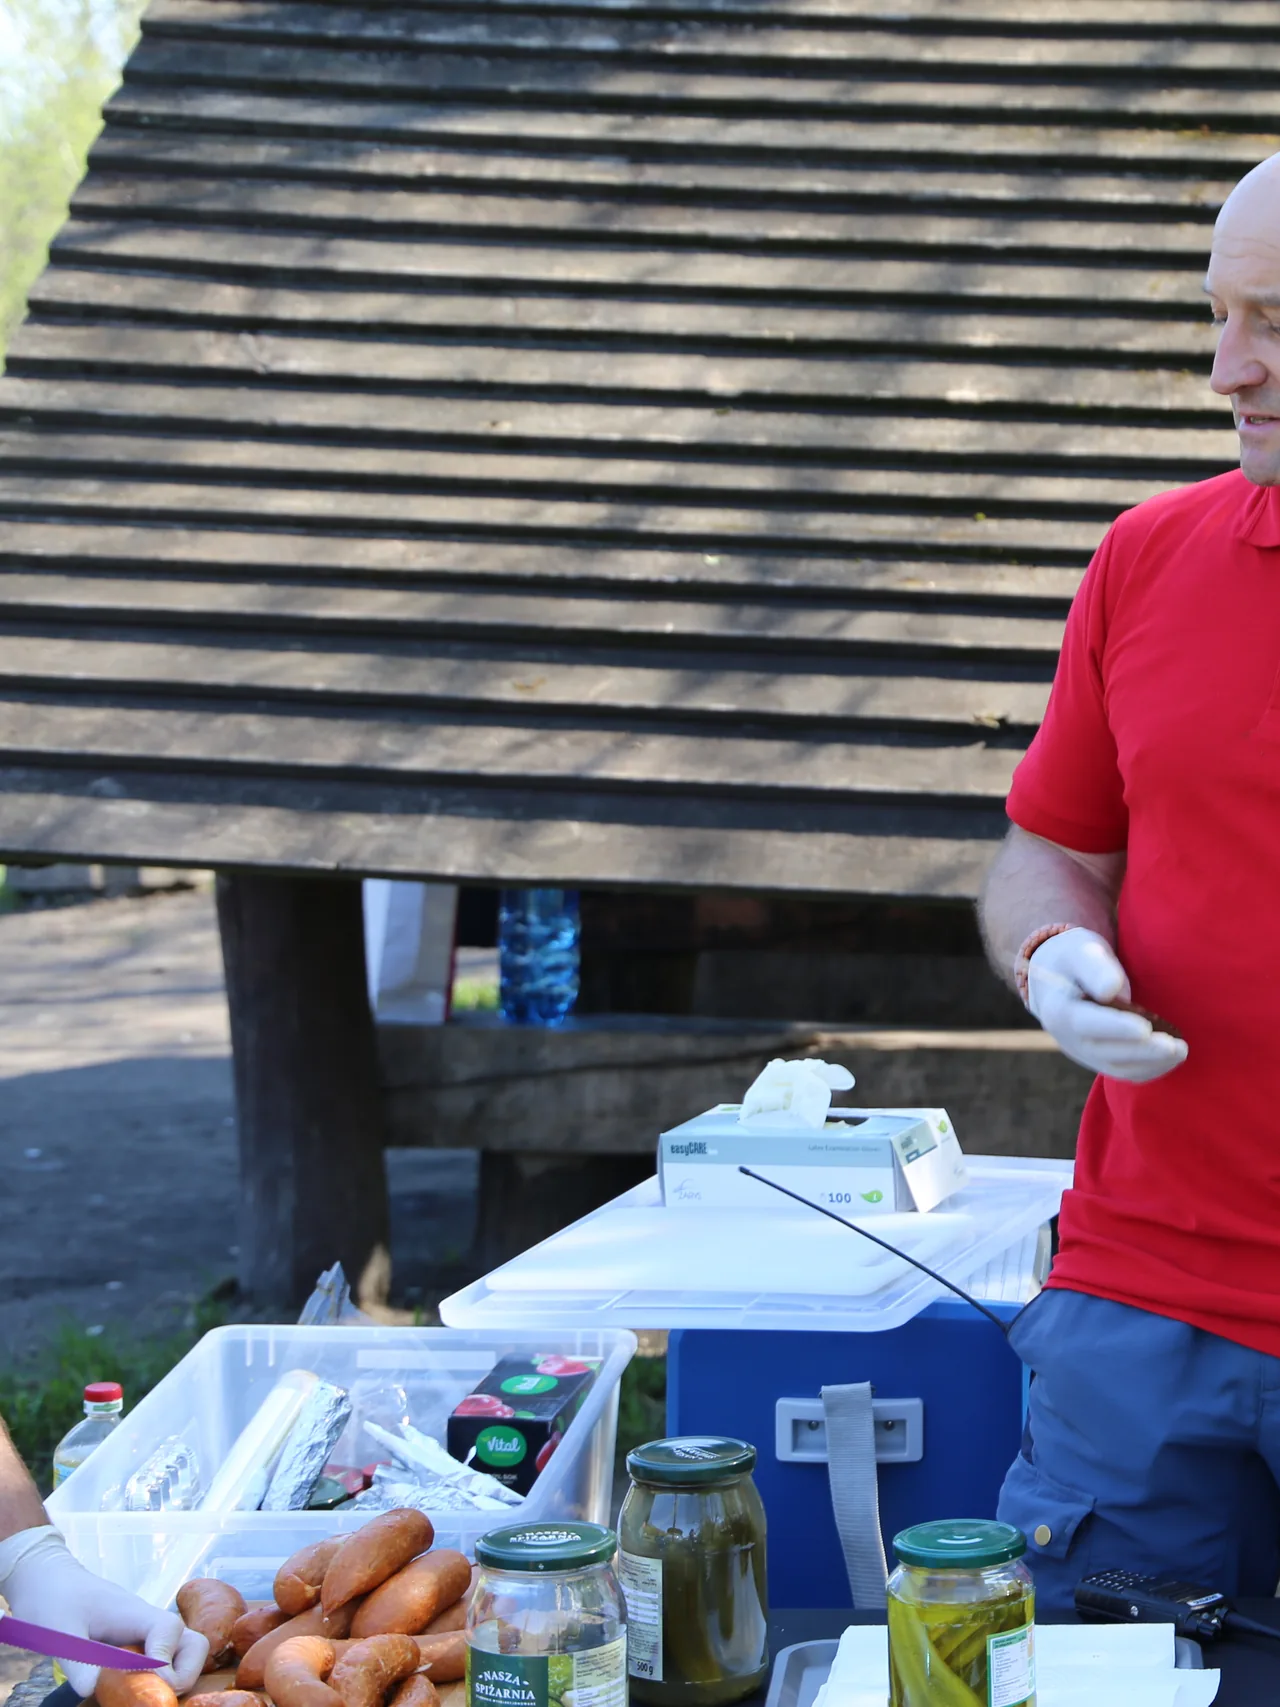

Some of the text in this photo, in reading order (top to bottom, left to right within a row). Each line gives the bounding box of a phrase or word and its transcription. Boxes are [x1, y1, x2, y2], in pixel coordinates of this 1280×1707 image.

[670, 1141, 707, 1156] easyCARE
[828, 1192, 852, 1203] 100
[487, 1436, 521, 1452] Vital
[636, 1661, 654, 1676] 500 g
[484, 1670, 520, 1686] NASZA
[475, 1682, 536, 1700] SPIŻARNIA
